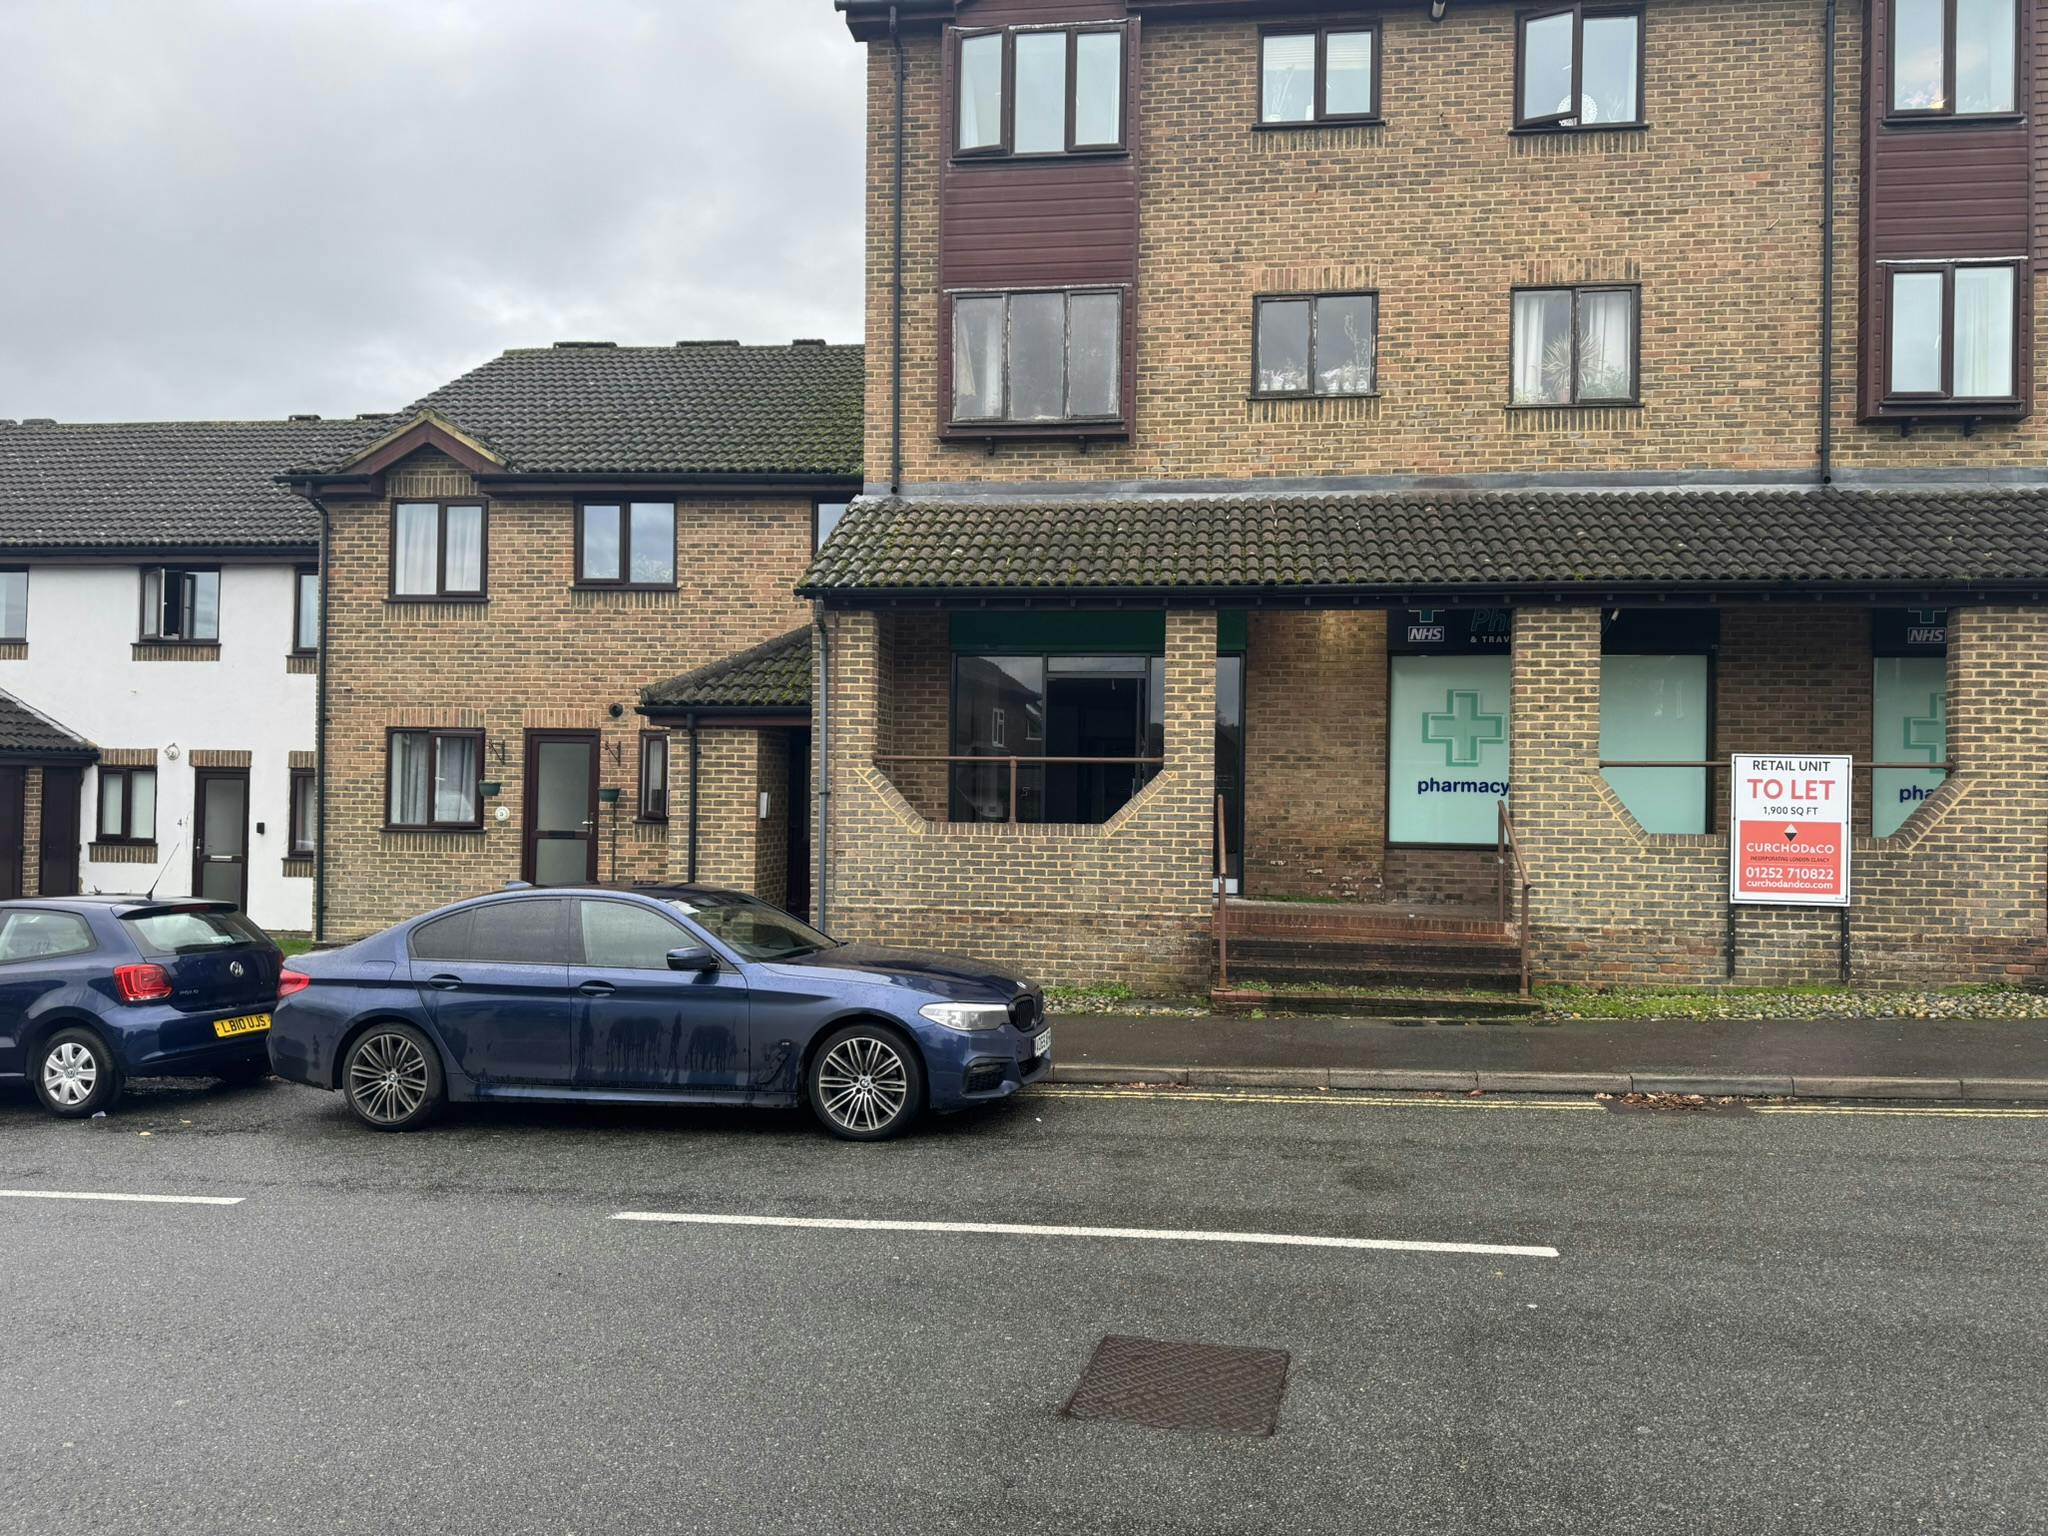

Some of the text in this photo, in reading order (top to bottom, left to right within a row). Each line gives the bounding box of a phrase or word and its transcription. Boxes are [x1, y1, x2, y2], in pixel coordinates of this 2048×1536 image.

[1409, 627, 1442, 640] NHS
[1470, 635, 1509, 643] & TRAV
[1910, 629, 1944, 642] NHS
[1752, 760, 1831, 772] RETAIL UNIT
[1417, 777, 1509, 796] pharmacy
[1747, 779, 1836, 801] TO LET
[1763, 806, 1818, 816] 1,900 SQ FT
[1746, 842, 1834, 854] CURCHOD&CO
[1746, 867, 1834, 880] 01252 710822
[1746, 879, 1833, 889] curchodandco.com
[221, 1015, 266, 1033] LB10 UJS
